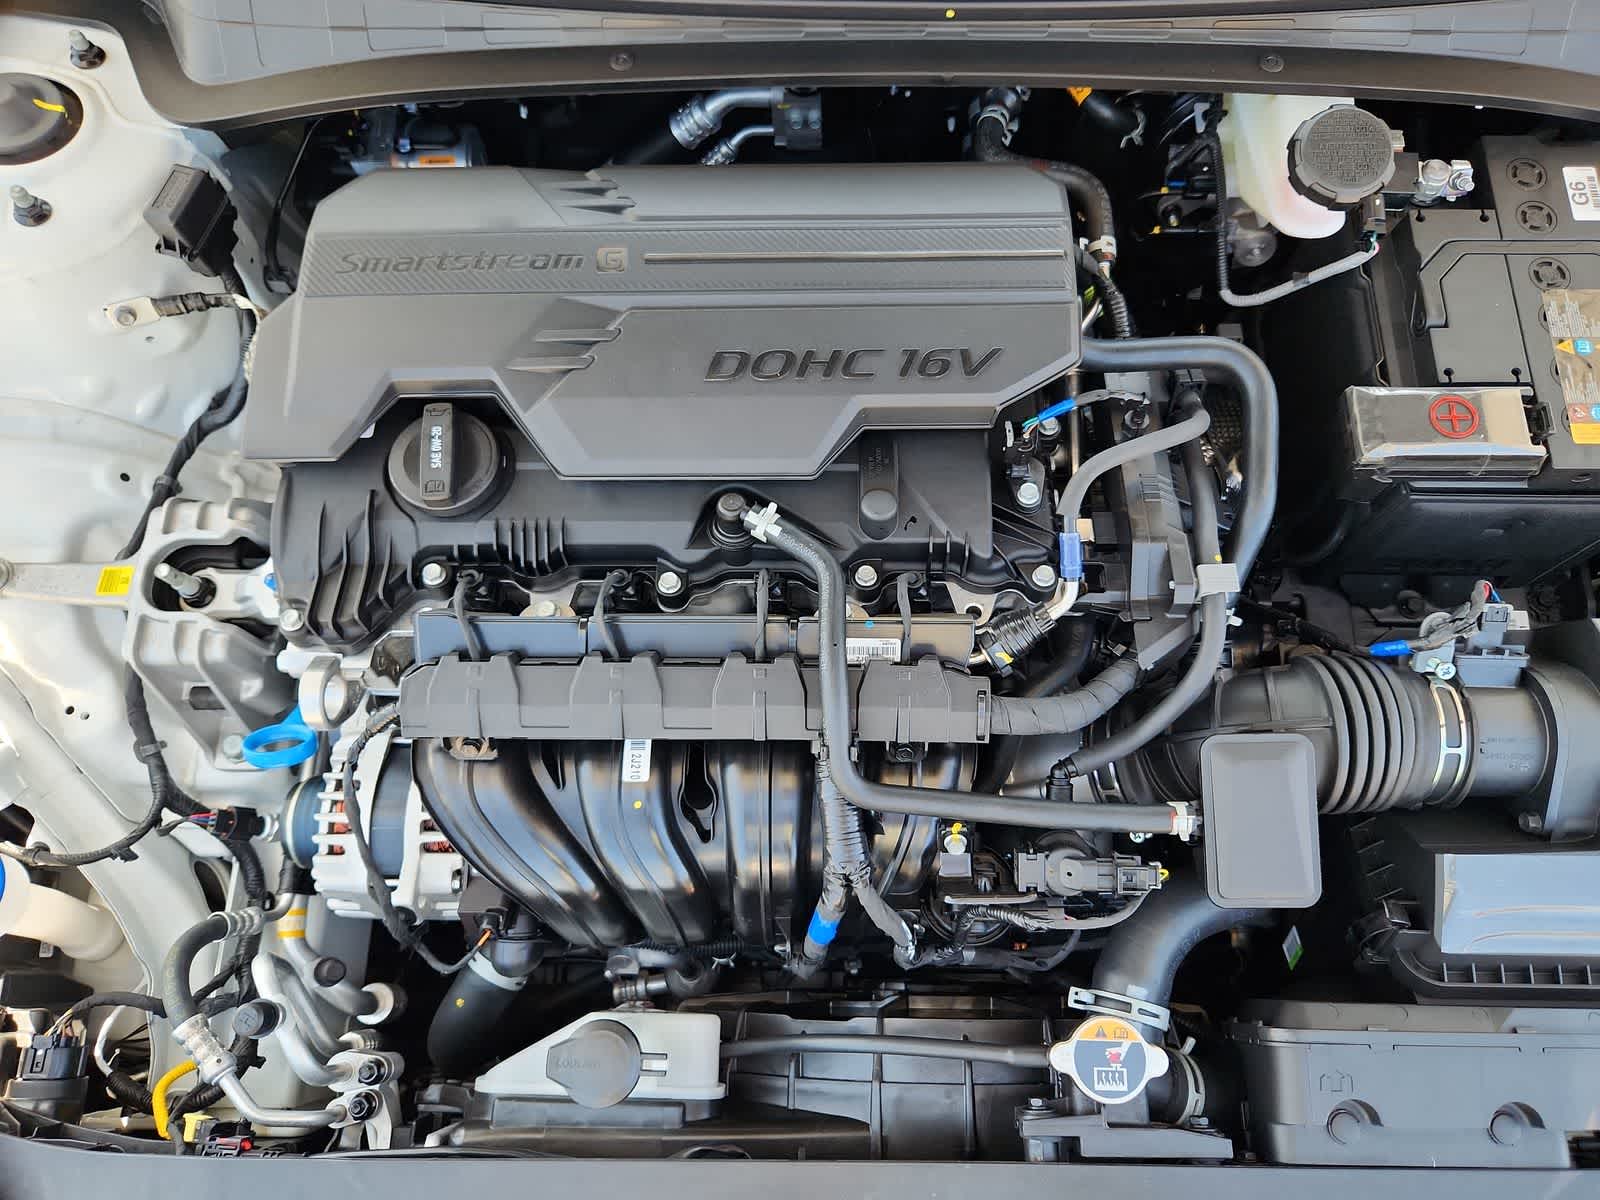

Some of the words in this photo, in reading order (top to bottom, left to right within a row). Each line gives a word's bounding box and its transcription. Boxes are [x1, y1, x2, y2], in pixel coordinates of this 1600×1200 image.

[1569, 181, 1590, 205] G6
[335, 251, 585, 275] Smartstream
[704, 348, 884, 381] DOHC
[899, 347, 1004, 379] 16V
[430, 425, 443, 451] 0W-20
[430, 452, 442, 469] SAE
